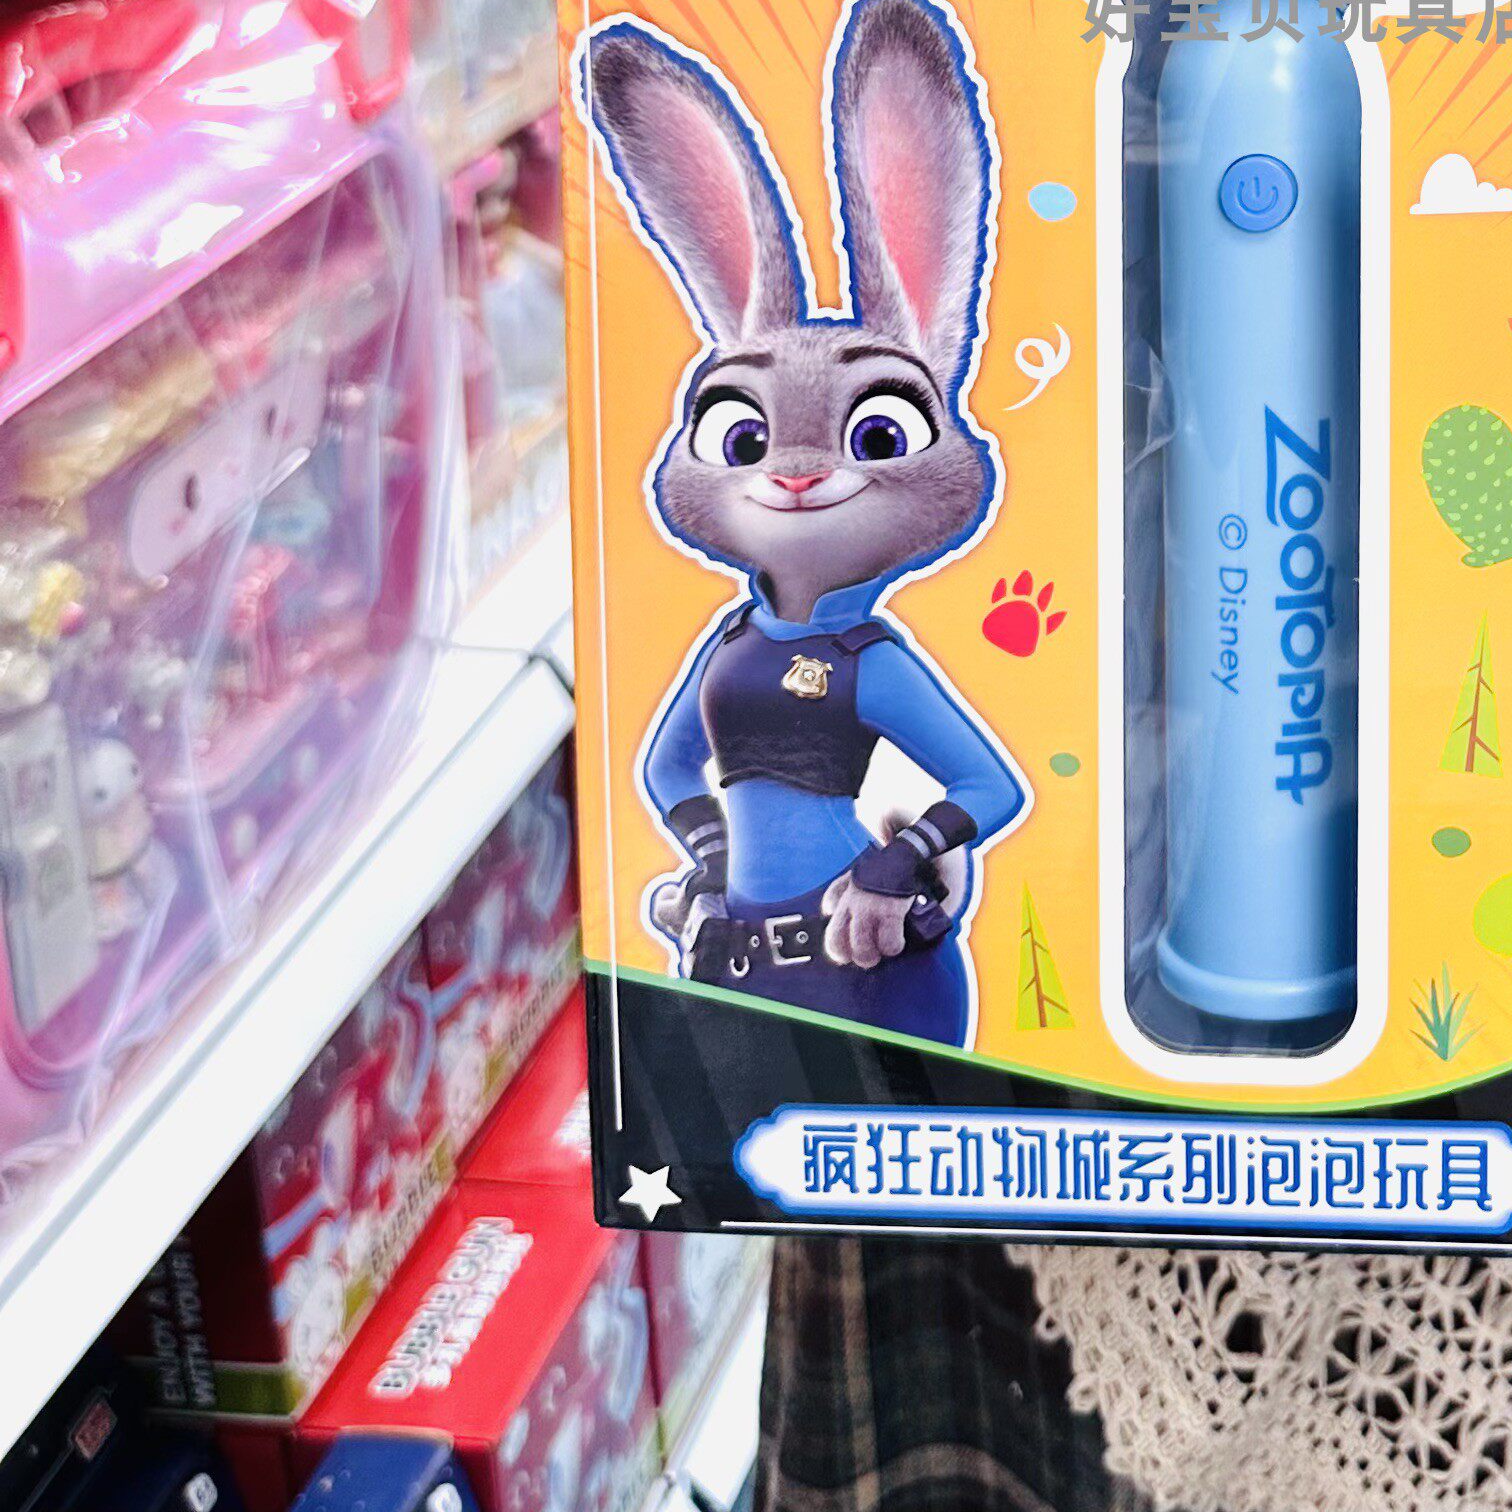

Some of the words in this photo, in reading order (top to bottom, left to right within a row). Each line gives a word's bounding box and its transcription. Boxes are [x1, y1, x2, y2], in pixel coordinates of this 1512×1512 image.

[1211, 568, 1248, 695] Disney
[1264, 404, 1335, 806] ZOOTOPIA
[803, 1122, 1493, 1212] 疯狂动物城系列泡泡玩具
